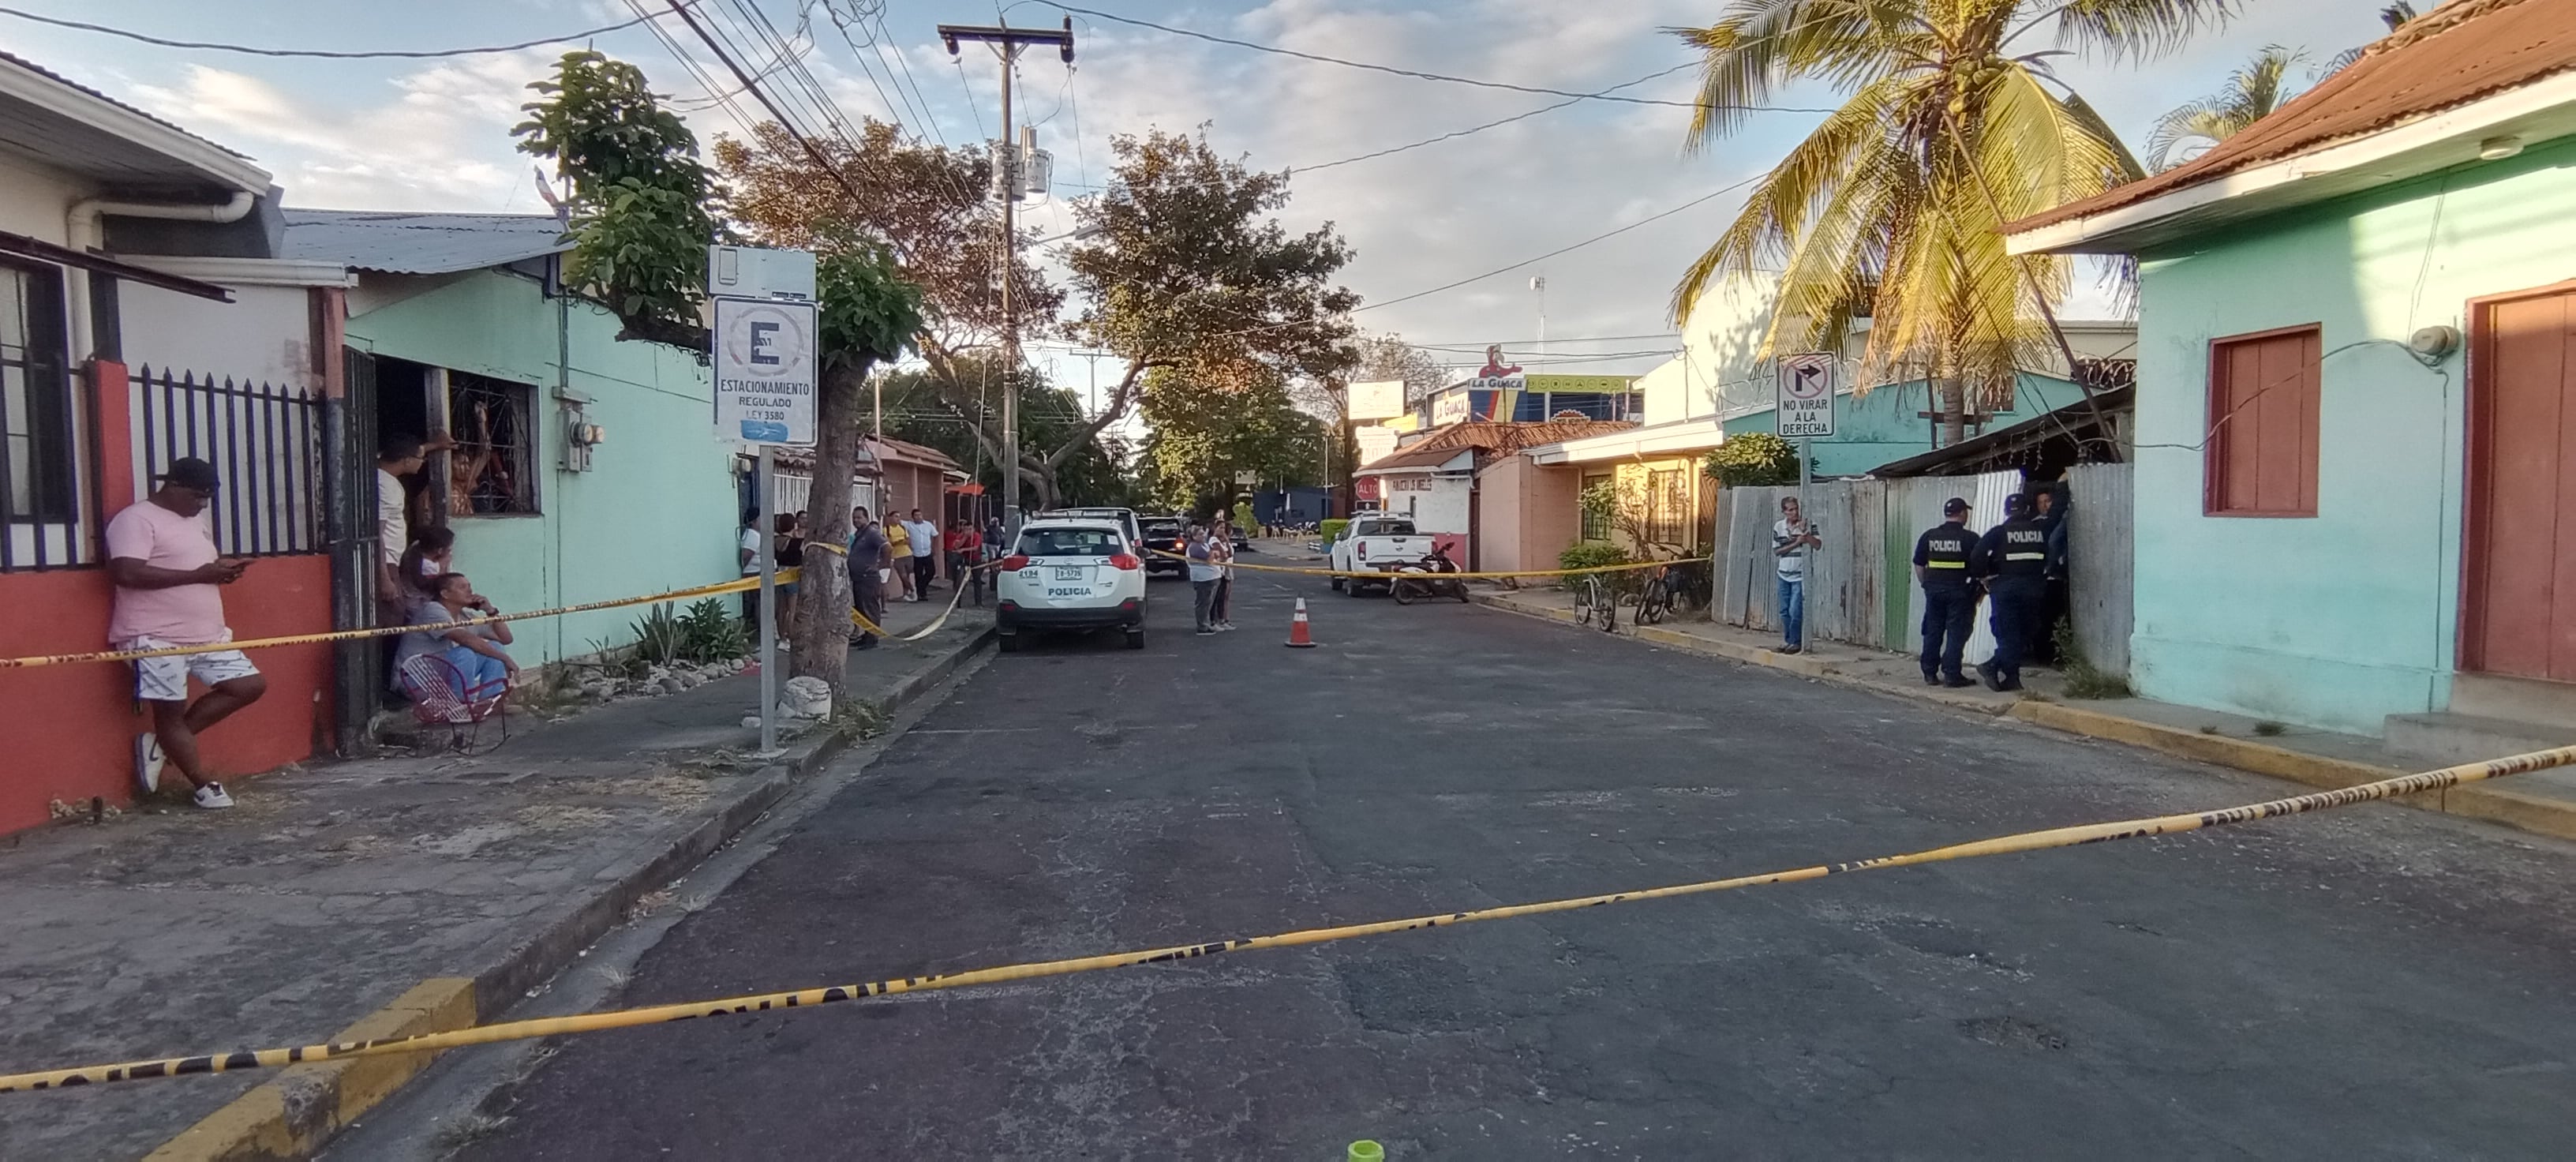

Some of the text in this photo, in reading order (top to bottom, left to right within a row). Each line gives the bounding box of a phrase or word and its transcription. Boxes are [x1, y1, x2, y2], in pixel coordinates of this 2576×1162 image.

[751, 321, 779, 365] E
[721, 379, 810, 395] ESTACIONAMIENTO
[1471, 379, 1485, 388] LA
[739, 396, 792, 407] REGULADO
[1784, 399, 1828, 410] NO VIRAR
[746, 410, 784, 420] LEY 3580
[1795, 411, 1816, 422] A LA
[1783, 423, 1828, 434] DERECHA
[1358, 485, 1377, 493] ALTO
[2007, 530, 2044, 543] POLICIA
[1929, 540, 1961, 552] POLICIA
[1048, 587, 1091, 596] POLICIA
